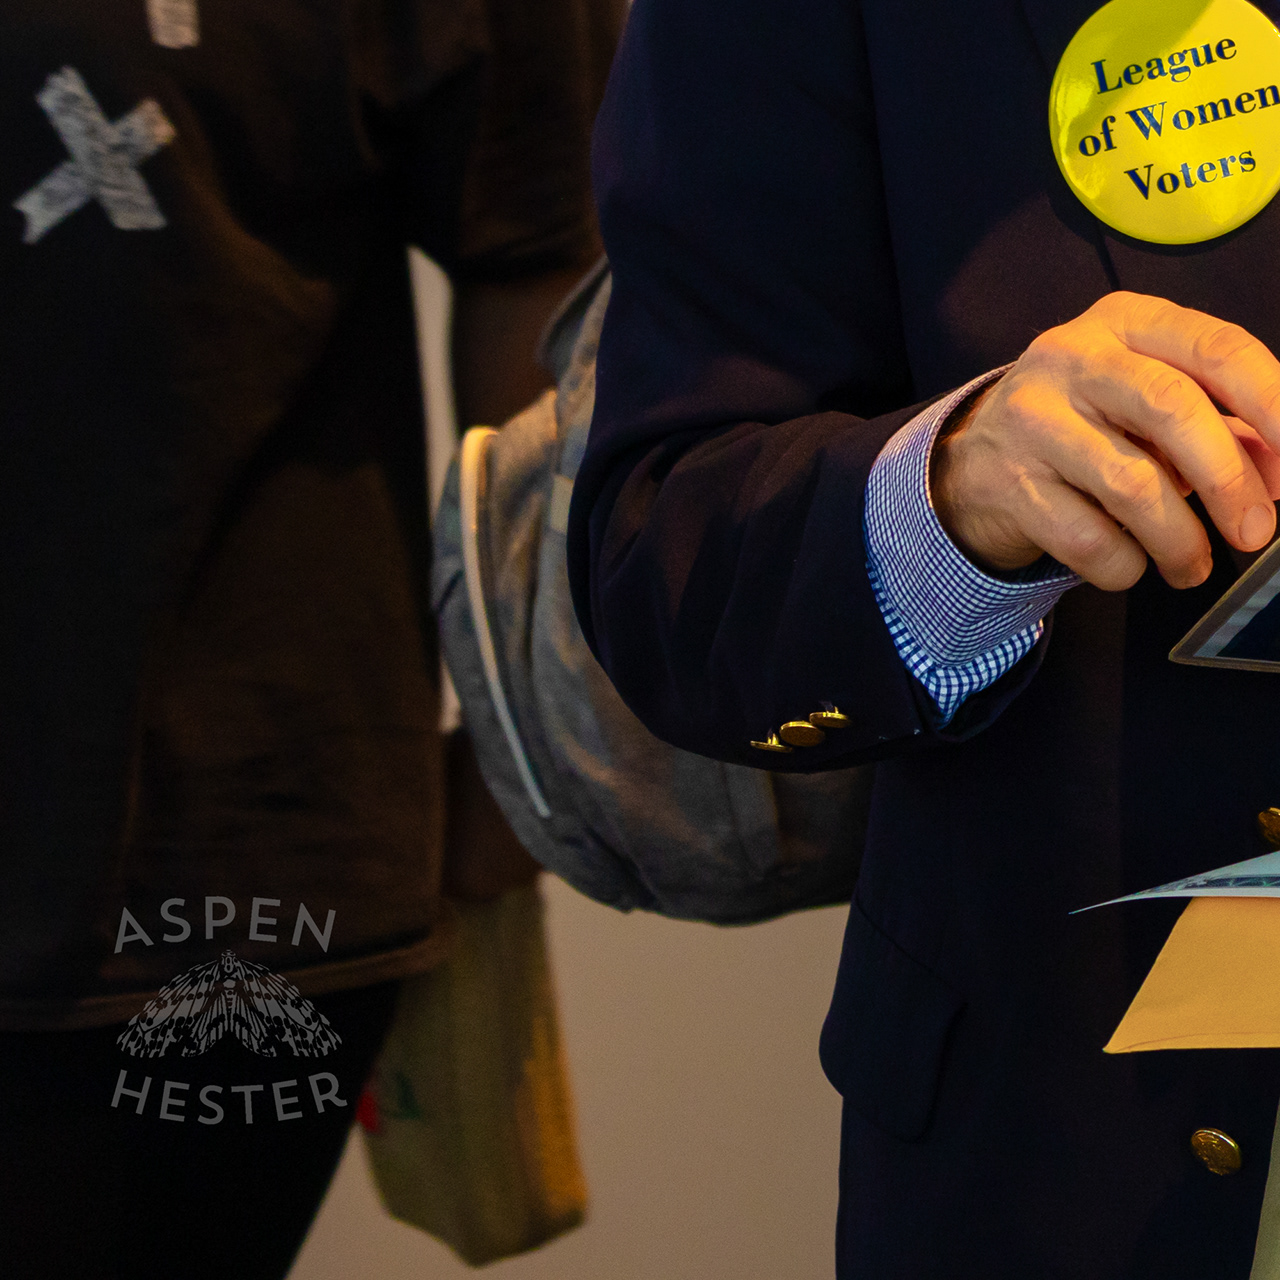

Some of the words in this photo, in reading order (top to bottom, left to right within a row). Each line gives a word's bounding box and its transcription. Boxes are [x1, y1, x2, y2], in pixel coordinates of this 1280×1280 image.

[1090, 37, 1238, 95] League
[1078, 115, 1118, 157] of
[1123, 150, 1257, 201] Voters
